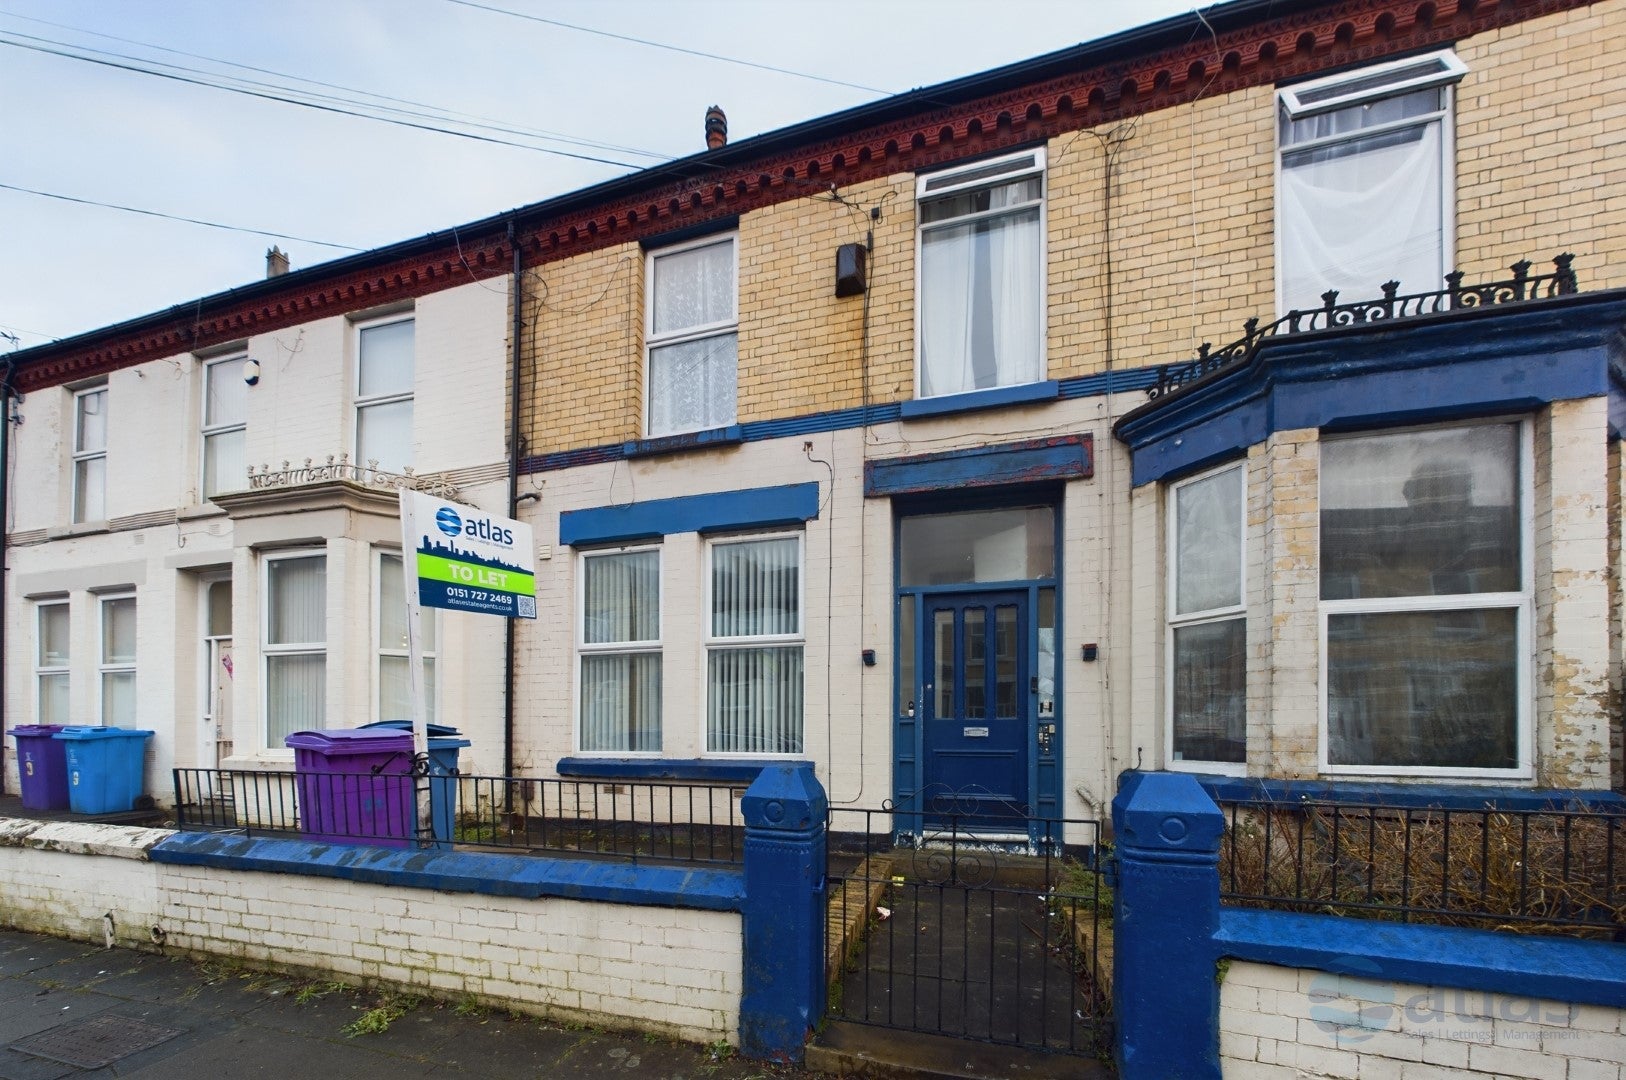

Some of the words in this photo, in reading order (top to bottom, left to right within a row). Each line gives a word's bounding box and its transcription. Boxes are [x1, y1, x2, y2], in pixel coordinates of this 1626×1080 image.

[466, 519, 513, 545] atlas
[448, 563, 473, 581] TO
[478, 569, 508, 587] LET
[447, 587, 468, 598] 0151
[471, 590, 487, 601] 727
[490, 594, 512, 604] 2469
[448, 598, 512, 611] atlasestateagents.co.uk
